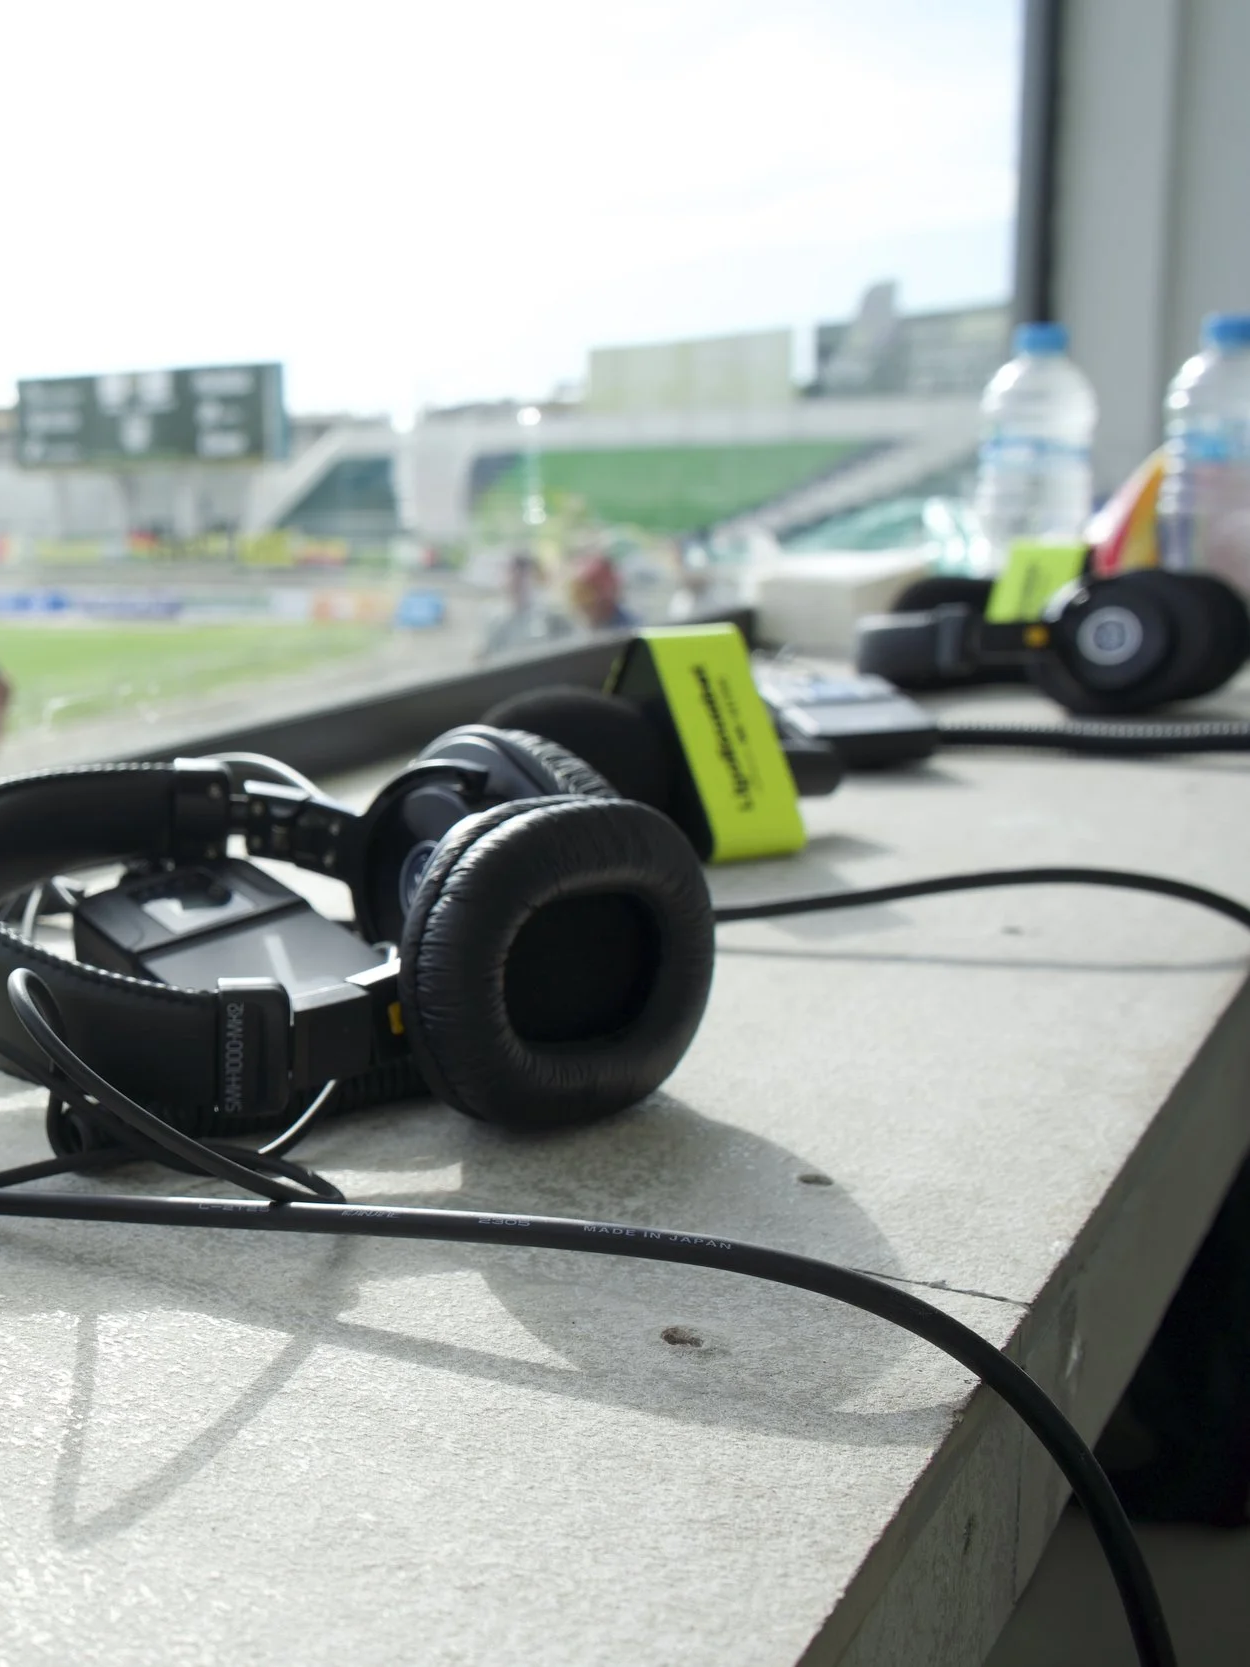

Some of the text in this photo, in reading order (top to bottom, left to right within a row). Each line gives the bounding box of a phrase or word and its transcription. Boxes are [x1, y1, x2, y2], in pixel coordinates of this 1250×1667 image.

[582, 1224, 636, 1237] MADE
[644, 1231, 661, 1240] IN
[669, 1234, 732, 1250] JAPAN
